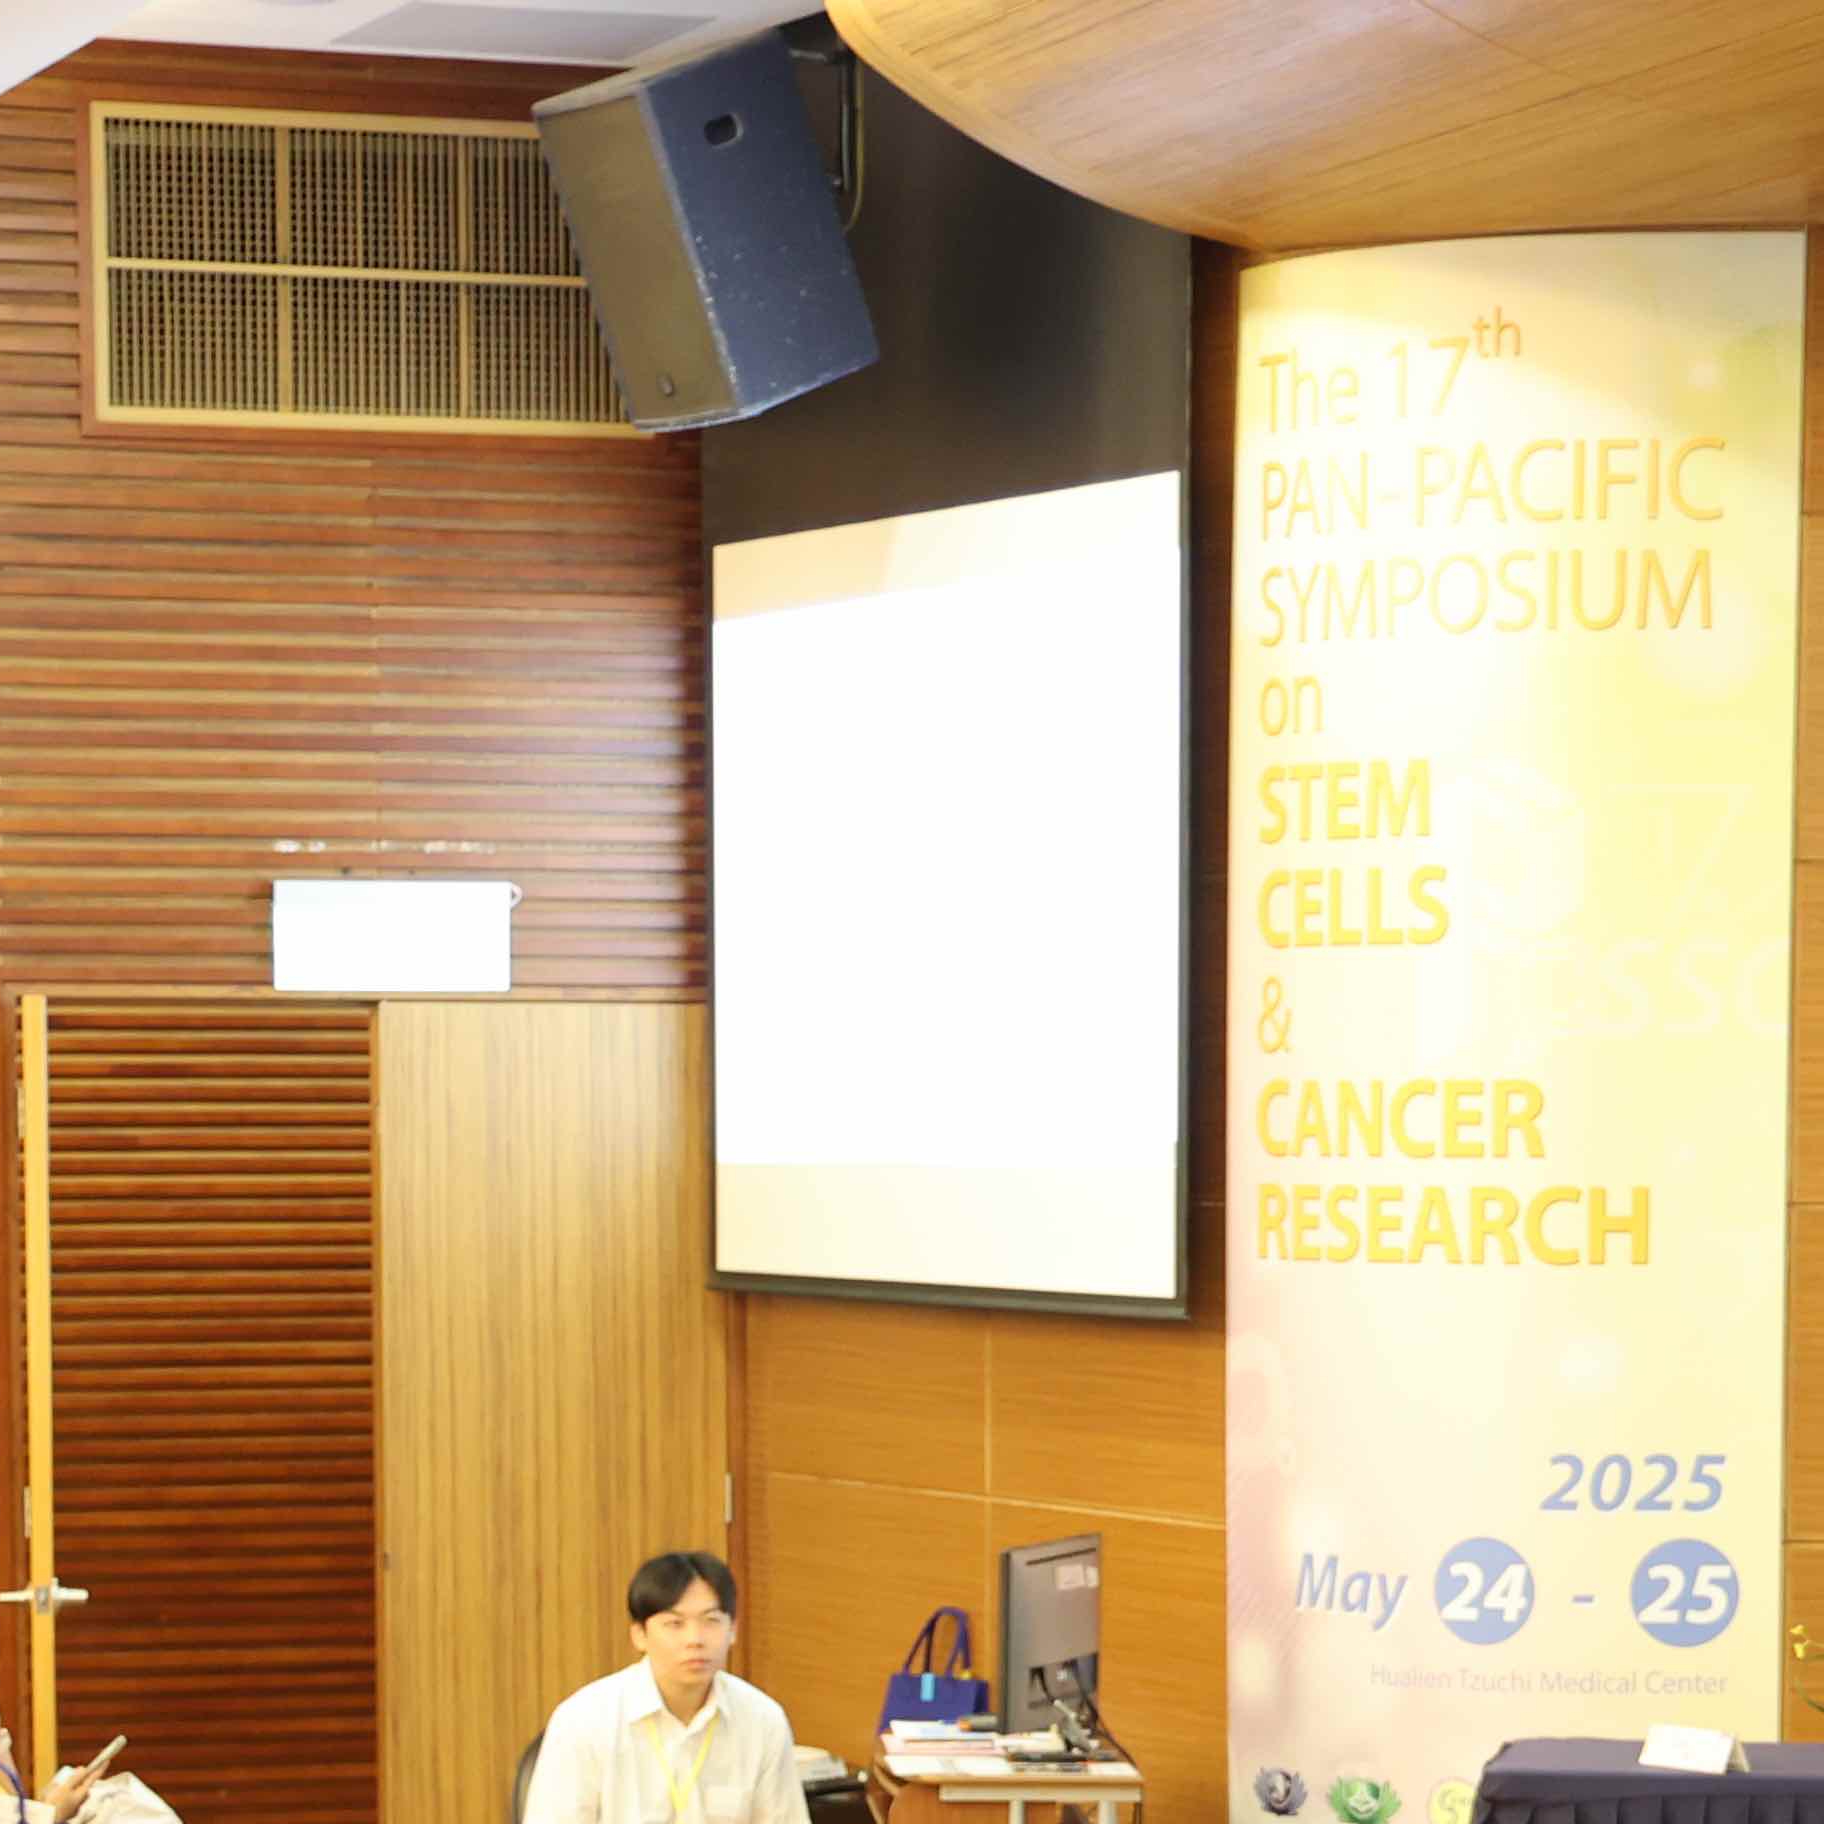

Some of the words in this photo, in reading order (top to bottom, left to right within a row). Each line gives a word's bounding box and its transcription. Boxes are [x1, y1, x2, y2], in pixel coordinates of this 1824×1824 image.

[1259, 349, 1359, 432] The
[1261, 436, 1725, 541] PAN-PACIFIC
[1258, 548, 1713, 647] SYMPOSIUM
[1258, 674, 1324, 735] on
[1258, 759, 1432, 844] STEM
[1257, 866, 1449, 948] CELLS
[1257, 976, 1292, 1053] &
[1256, 1079, 1545, 1159] CANCER
[1256, 1184, 1651, 1266] RESEARCH
[1540, 1454, 1725, 1511] 2025
[1295, 1552, 1408, 1628] May
[1439, 1562, 1528, 1623] 24
[1636, 1564, 1731, 1625] 25
[1540, 1669, 1636, 1695] Medical
[1645, 1670, 1729, 1695] Center
